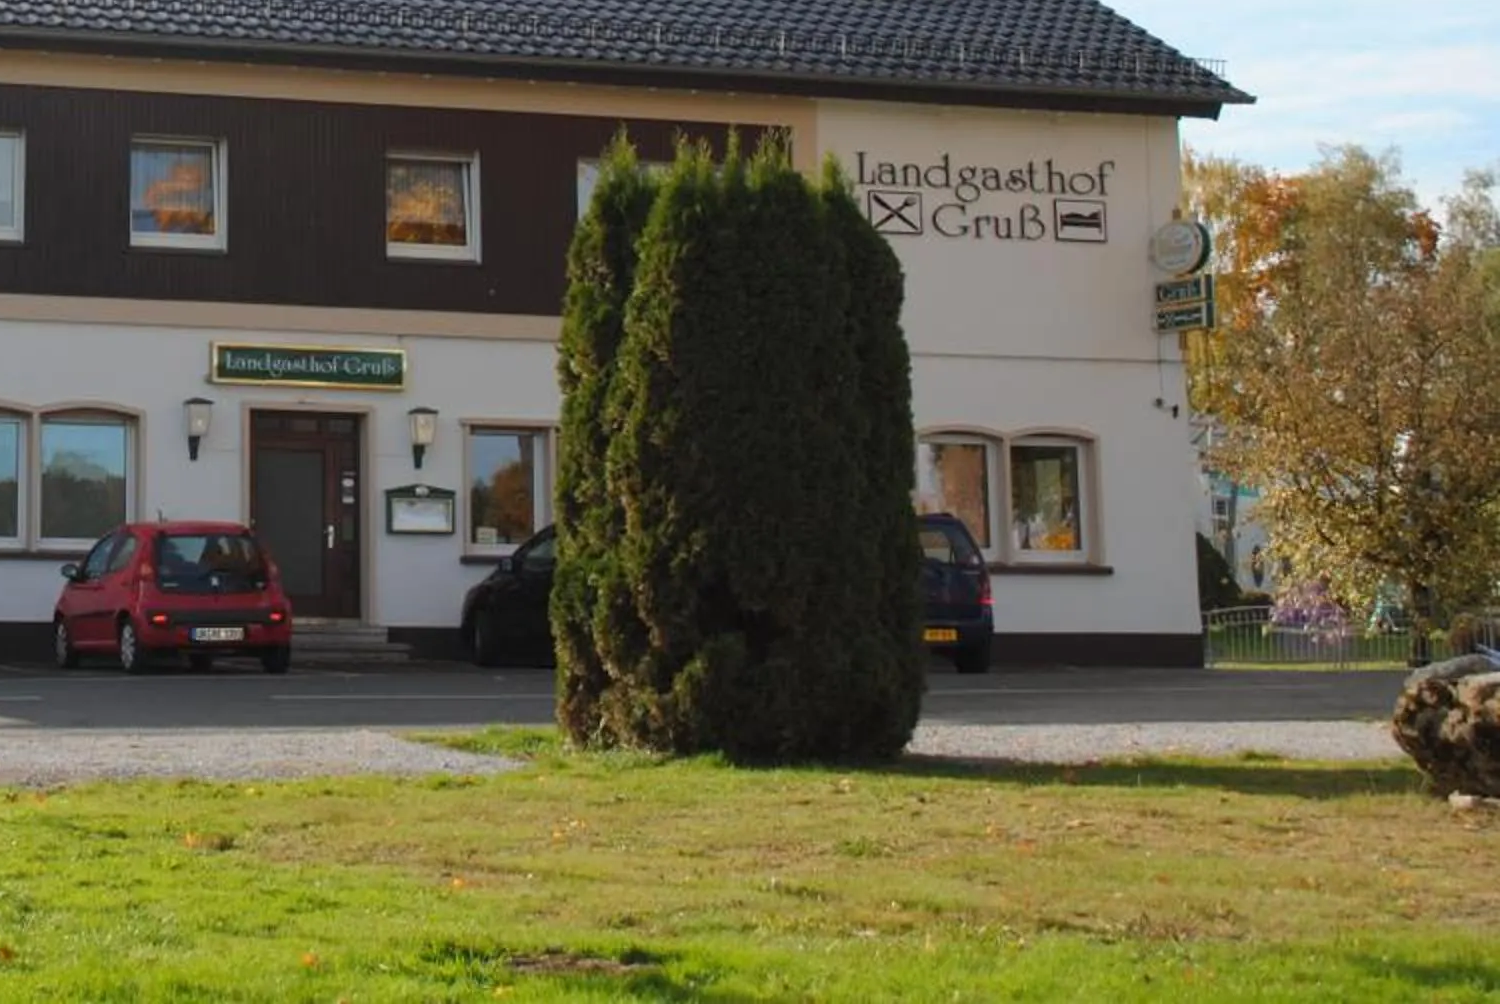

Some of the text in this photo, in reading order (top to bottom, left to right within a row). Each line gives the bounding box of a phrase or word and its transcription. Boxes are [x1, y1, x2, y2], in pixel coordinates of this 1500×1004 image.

[856, 151, 1115, 202] Landgasthof
[932, 203, 1045, 240] Gruß
[225, 351, 399, 379] Landgasthof Gruß
